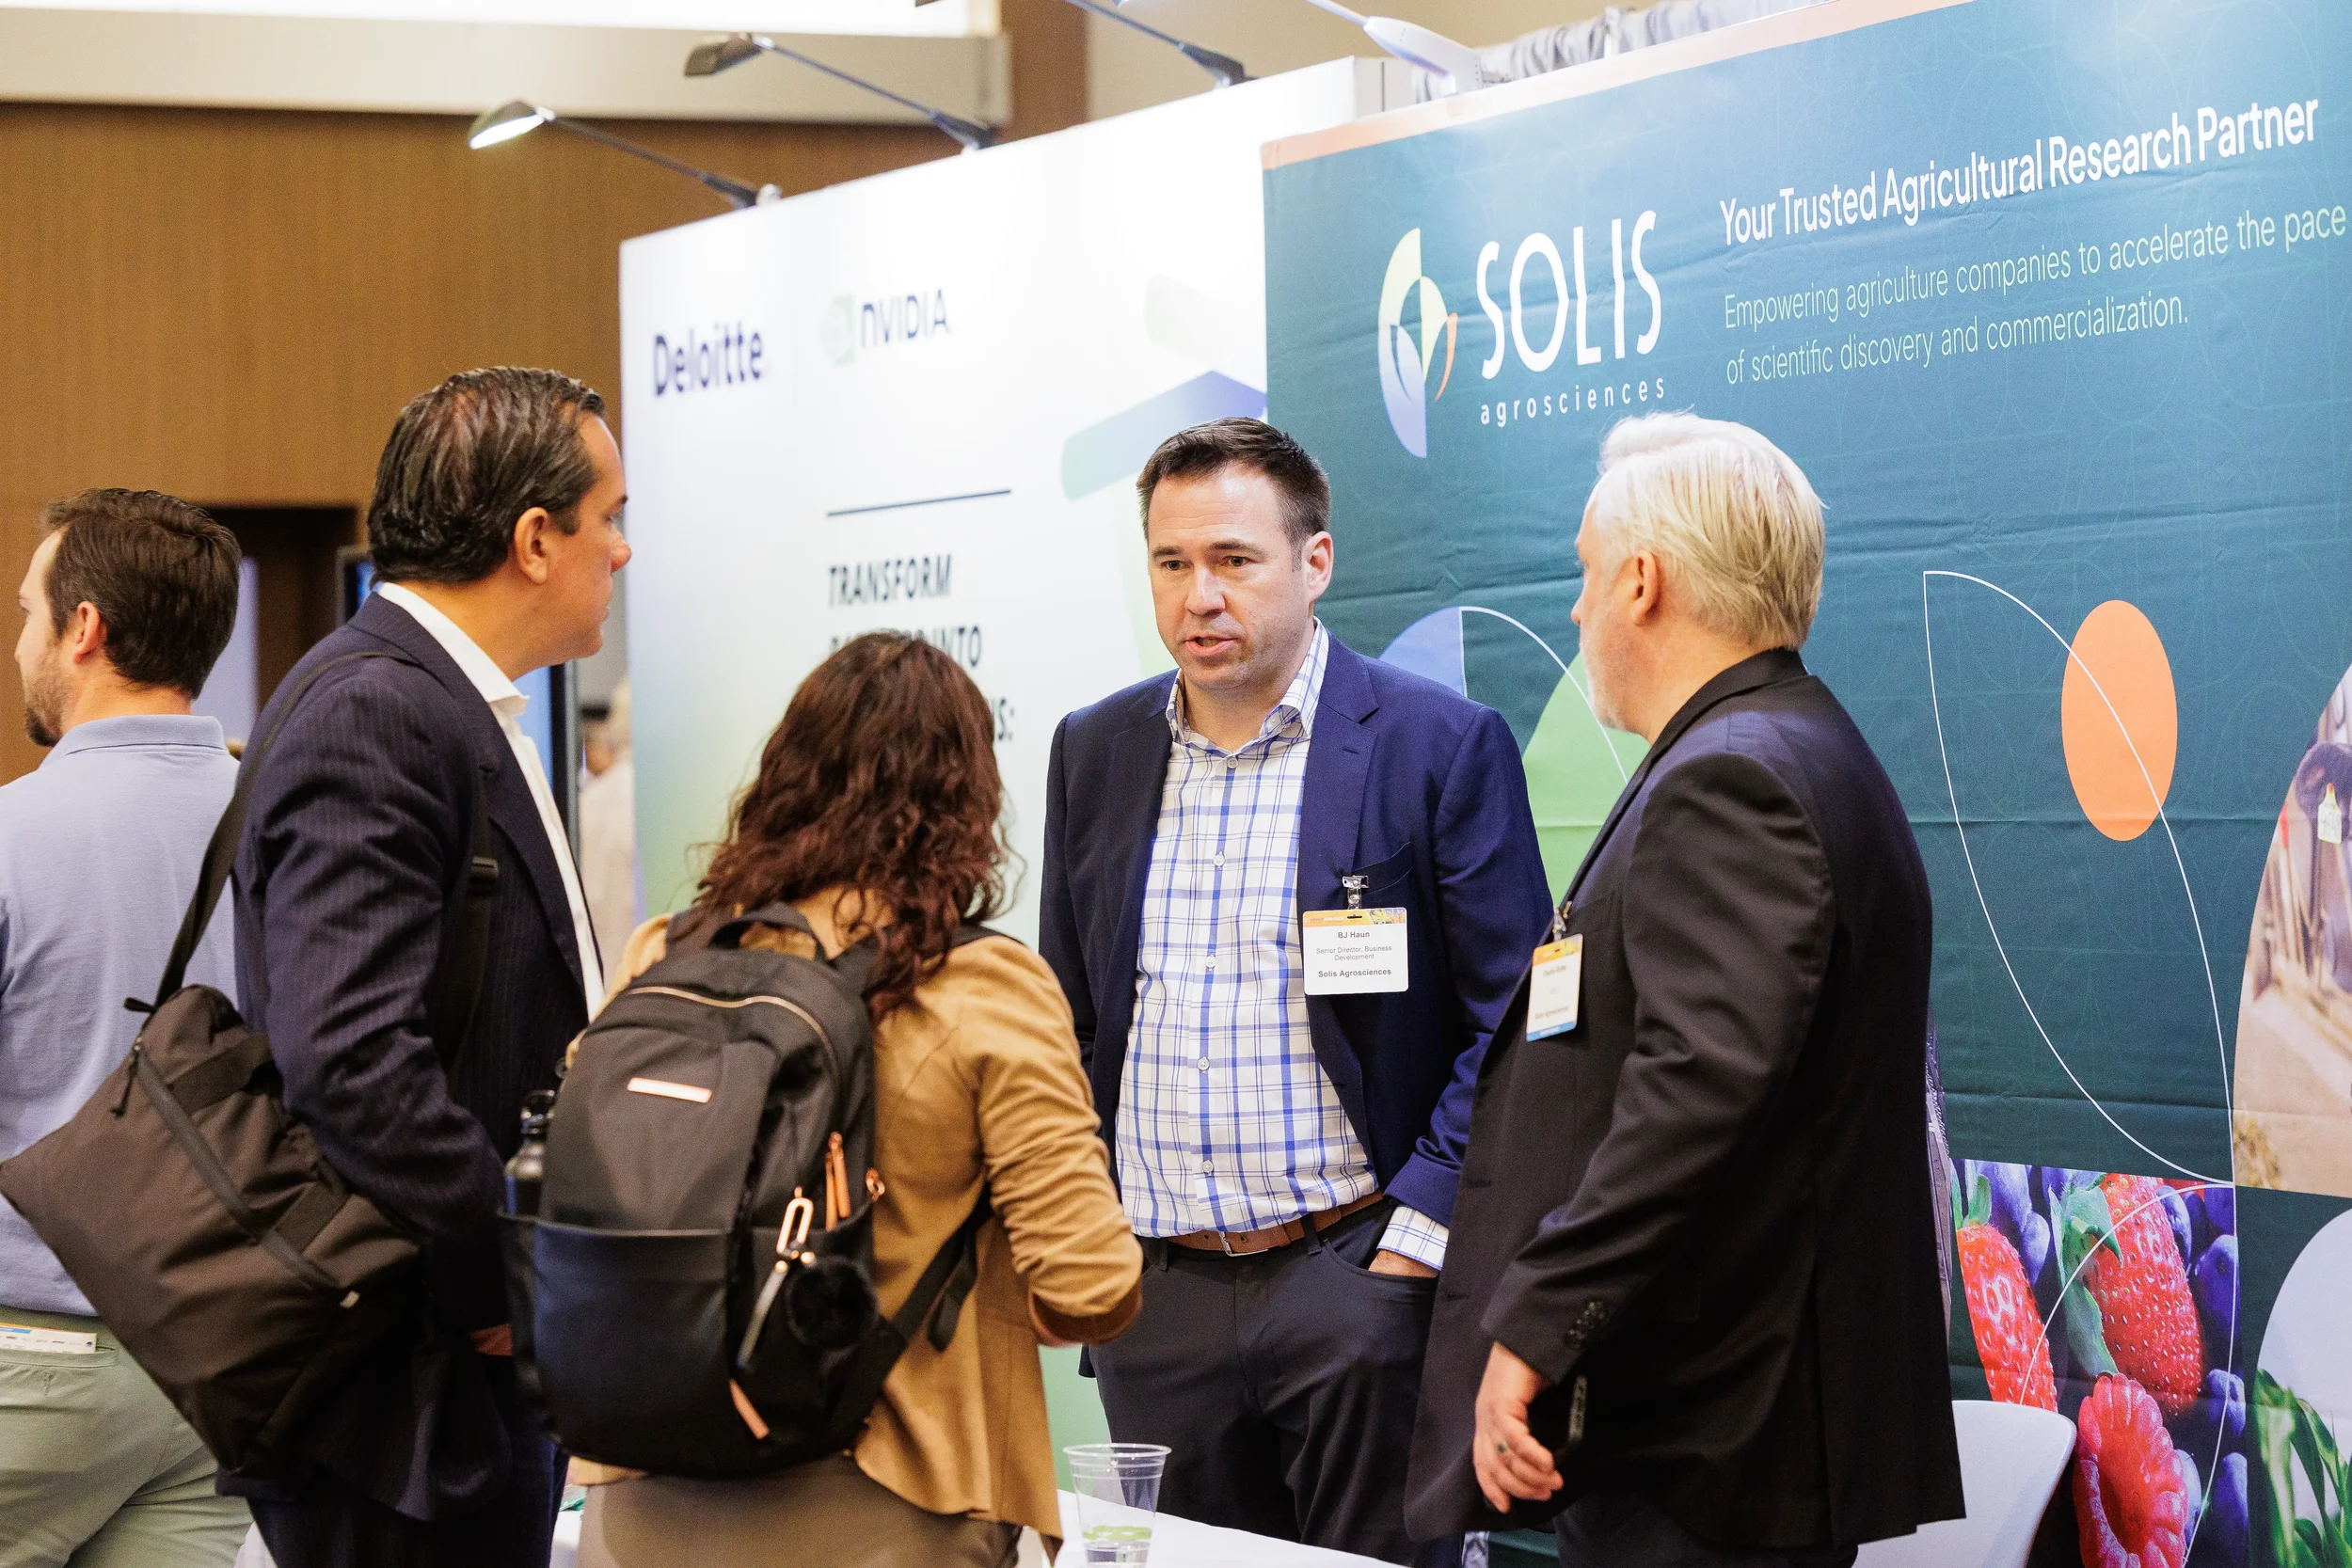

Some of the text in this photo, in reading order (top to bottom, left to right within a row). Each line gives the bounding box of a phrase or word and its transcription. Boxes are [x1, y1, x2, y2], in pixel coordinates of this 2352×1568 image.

[1719, 98, 2320, 246] Your Trusted Agricultural Research Partner
[1474, 209, 1662, 380] SOLIS
[1724, 204, 2347, 333] Empowering agriculture companies to accelerate the pace
[653, 320, 763, 398] Deloitte
[1725, 289, 2189, 385] of scientific discovery and commercialization.
[1479, 376, 1665, 429] agrosciences
[828, 553, 952, 608] TRANSFORM
[1315, 944, 1392, 955] Senior Director, Business
[1317, 968, 1392, 978] Solis Agrosciences
[1334, 953, 1375, 961] Development
